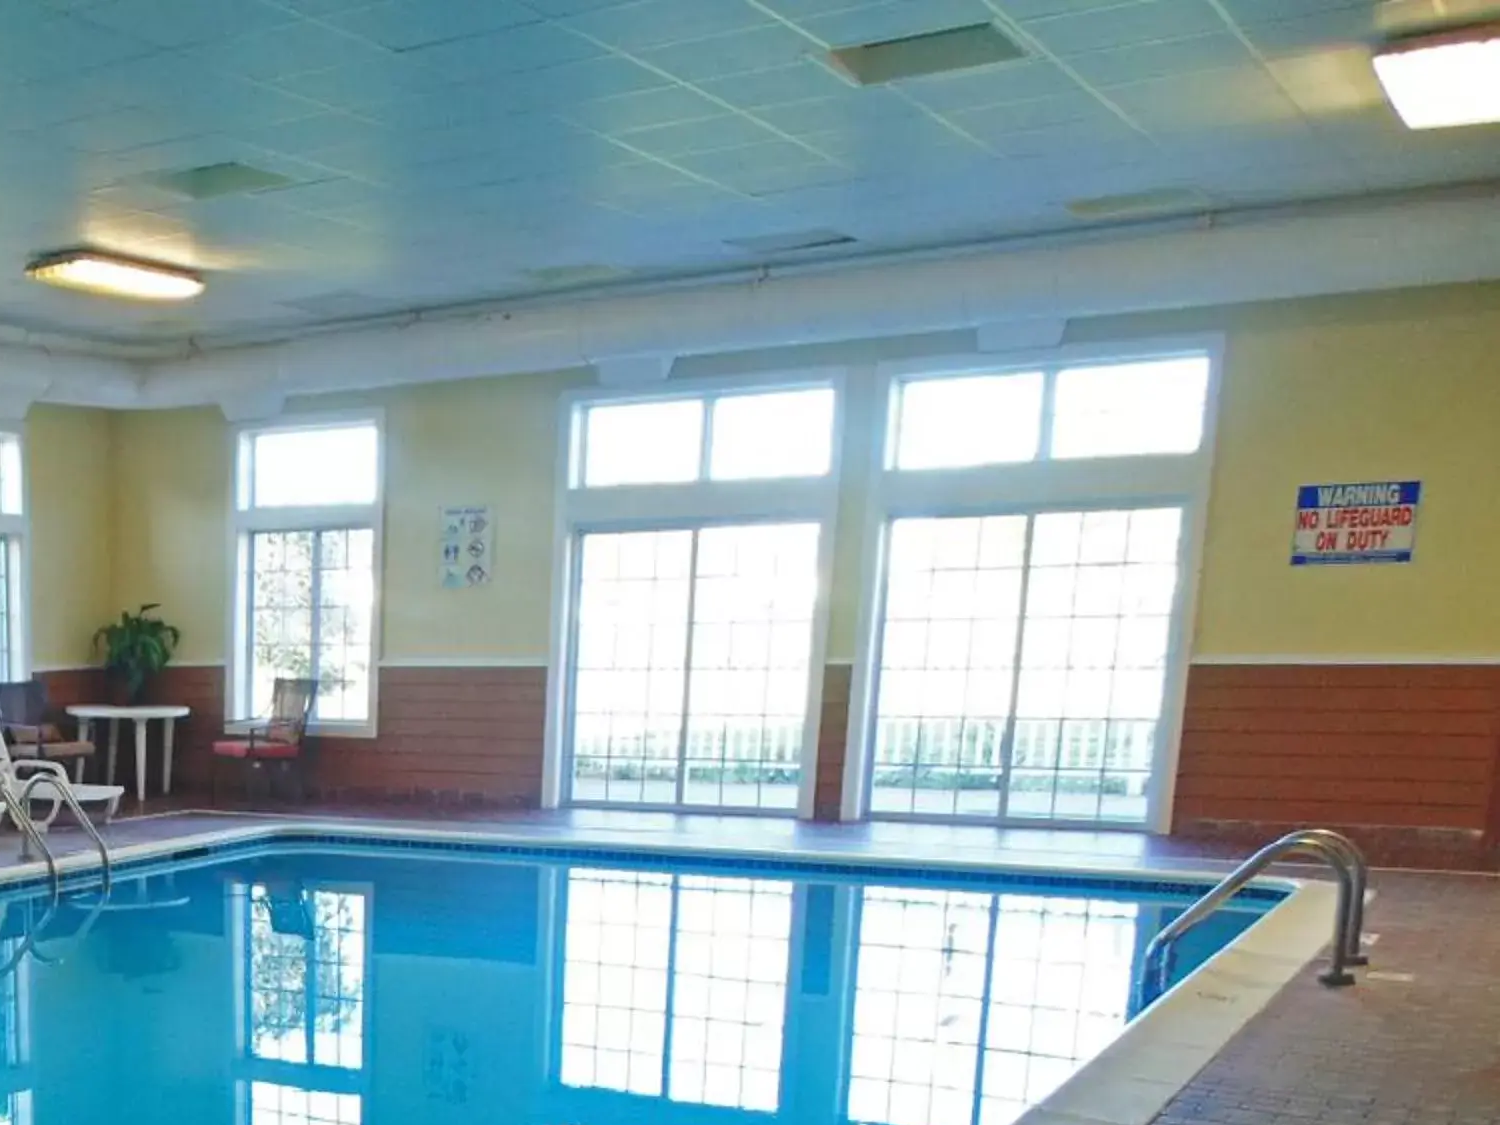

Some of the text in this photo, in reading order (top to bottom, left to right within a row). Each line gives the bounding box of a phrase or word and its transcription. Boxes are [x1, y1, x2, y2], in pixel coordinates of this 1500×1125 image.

[1318, 484, 1400, 506] WARNING
[1298, 506, 1413, 530] NO LIFEGUARD
[1315, 530, 1390, 551] ON DUTY
